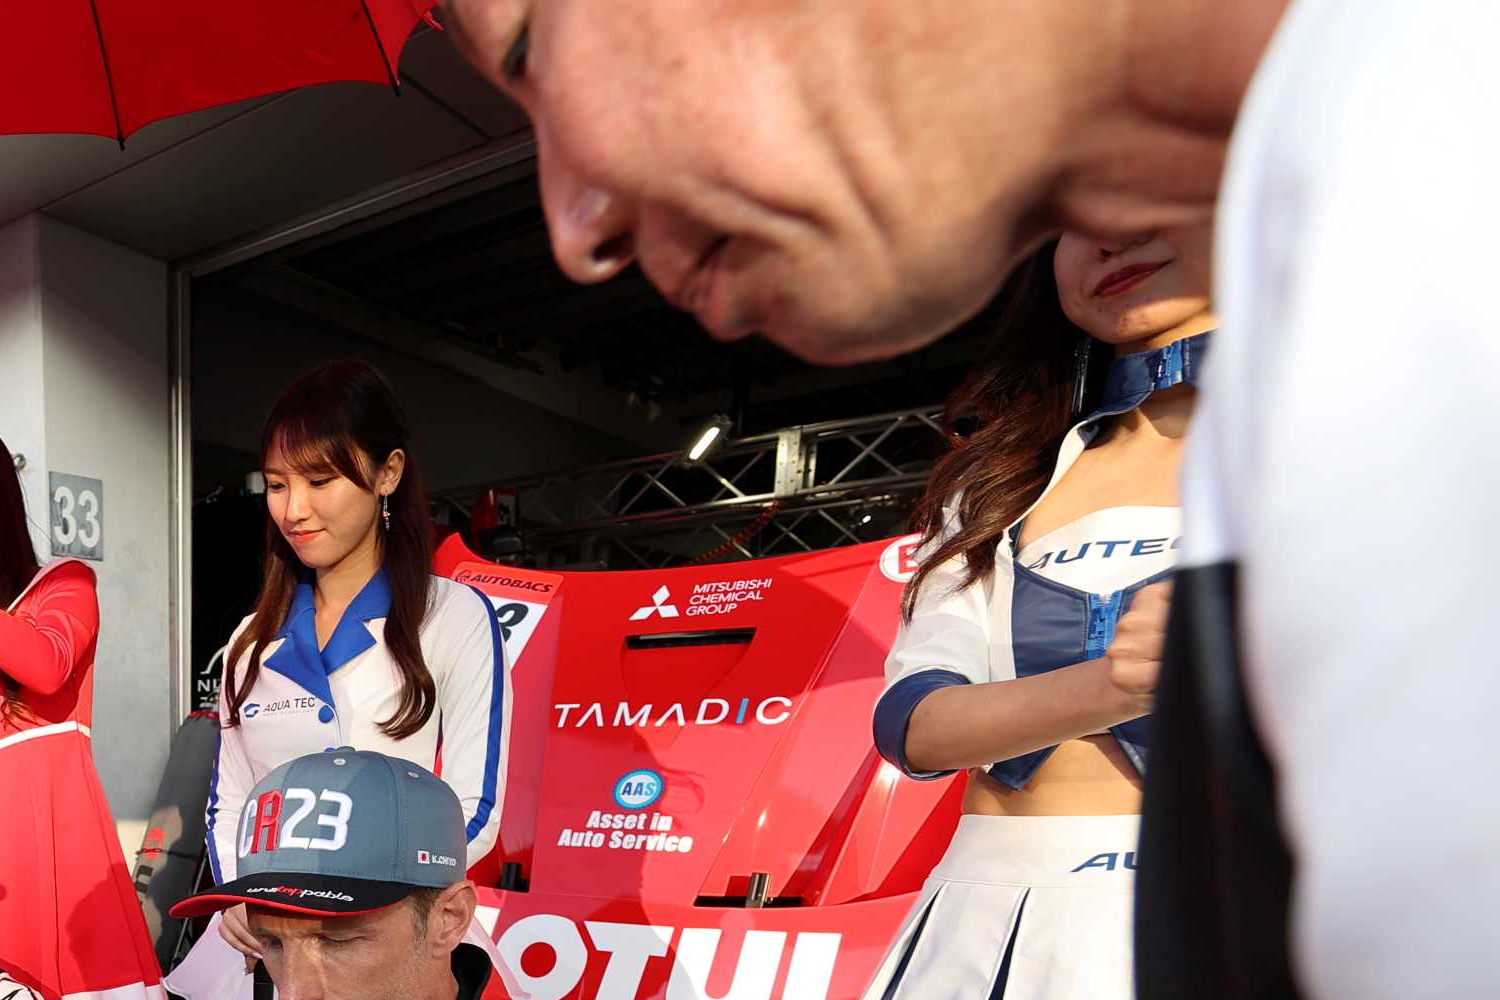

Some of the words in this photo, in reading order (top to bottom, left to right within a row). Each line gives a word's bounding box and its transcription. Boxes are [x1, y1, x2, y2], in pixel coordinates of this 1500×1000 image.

[53, 486, 100, 549] 33
[470, 574, 554, 593] AUTOBACS
[692, 578, 773, 594] MITSUBISHI
[689, 590, 764, 606] CHEMICAL
[685, 602, 738, 617] GROUP
[263, 700, 291, 713] AQUA
[294, 697, 316, 709] TEC
[554, 696, 793, 728] TAMADIC
[620, 780, 658, 798] AAS
[586, 810, 645, 831] Asset
[649, 811, 673, 831] in
[557, 829, 604, 849] Auto
[608, 831, 693, 853] Service
